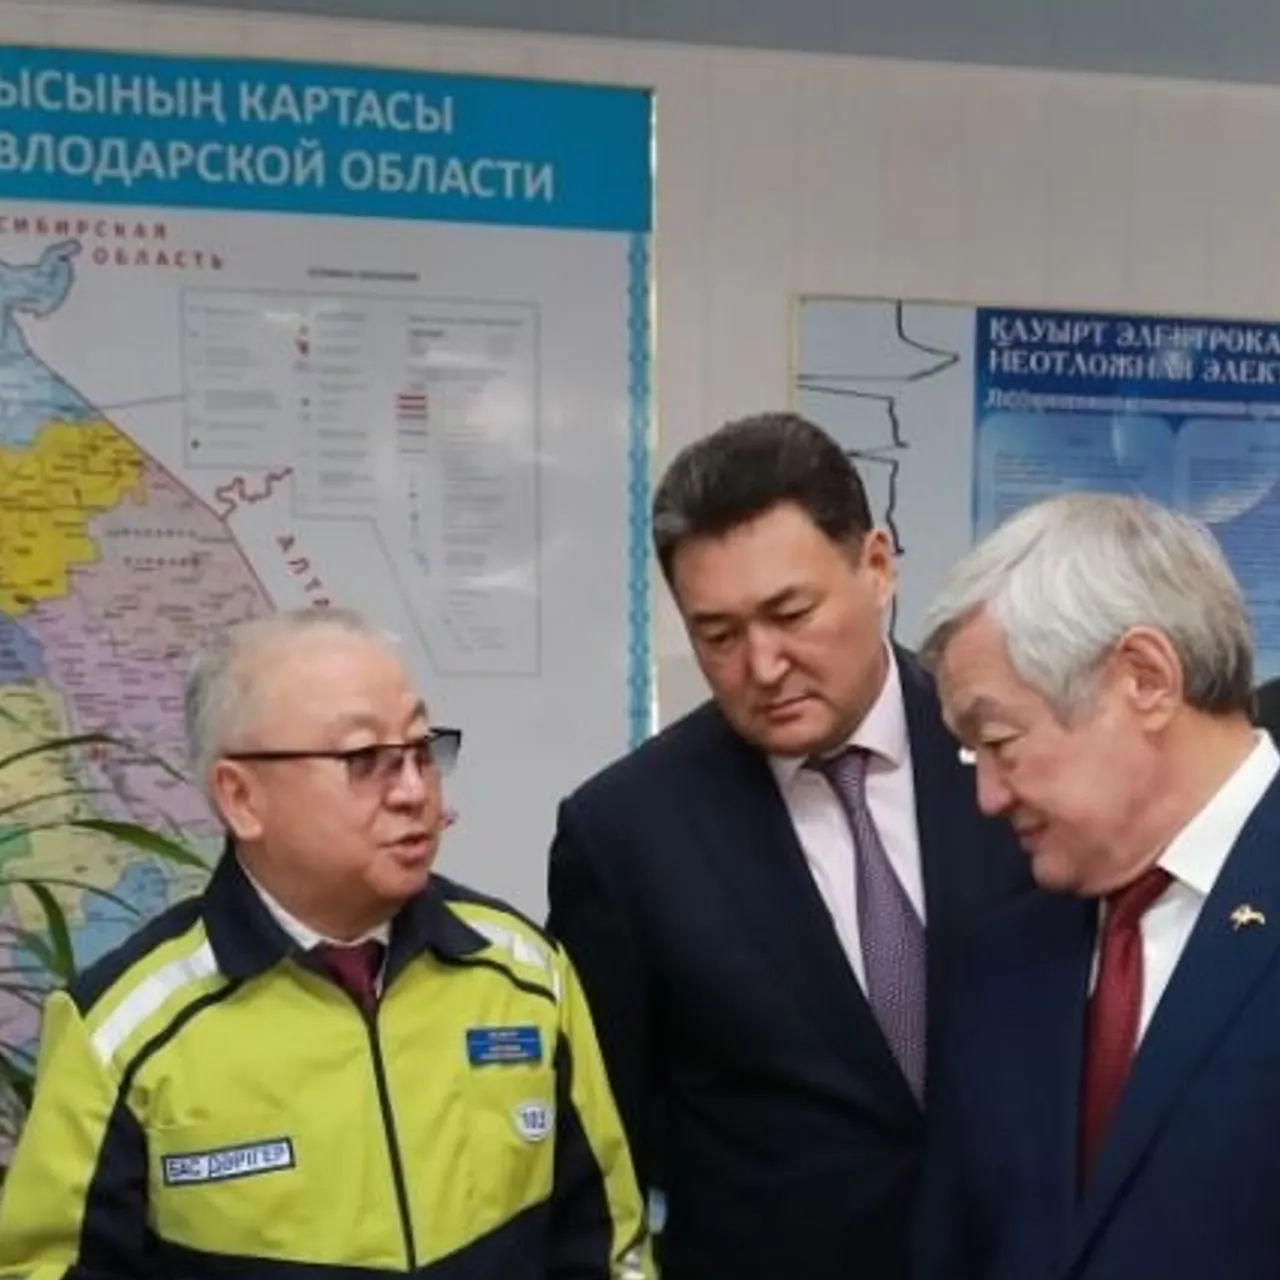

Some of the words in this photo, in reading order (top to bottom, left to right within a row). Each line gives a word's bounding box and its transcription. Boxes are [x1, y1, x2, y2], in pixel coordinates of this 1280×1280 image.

[238, 81, 454, 134] КАРТАСЫ
[340, 149, 555, 203] ОБЛАСТИ
[91, 245, 226, 271] ОБЛАСТЬ
[989, 348, 1195, 381] НЕОТЛОЖНАЯ
